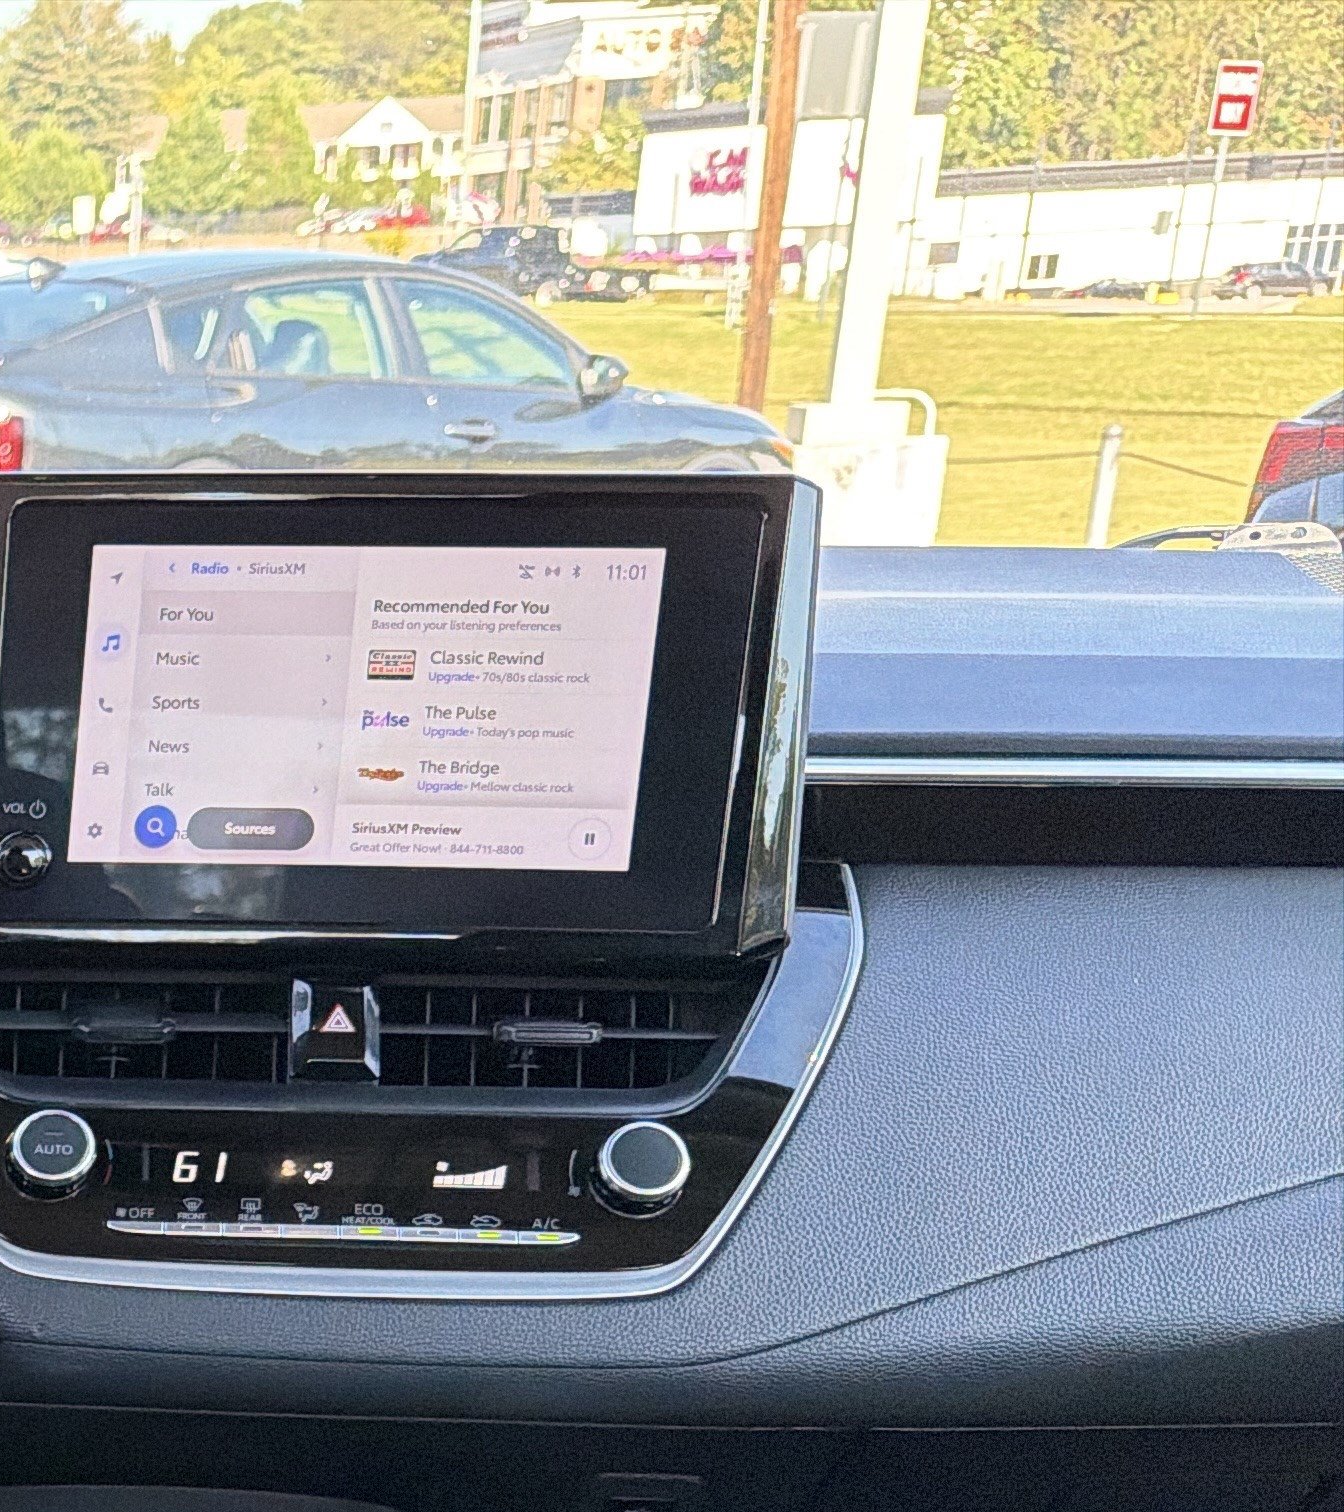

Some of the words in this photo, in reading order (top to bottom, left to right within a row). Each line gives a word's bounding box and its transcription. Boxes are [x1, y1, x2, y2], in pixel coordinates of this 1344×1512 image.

[190, 562, 229, 575] Radio
[248, 562, 307, 576] SiriusXM
[606, 564, 648, 581] 11:01
[159, 607, 183, 622] For
[186, 607, 214, 622] You
[373, 600, 490, 615] Recommended
[493, 600, 518, 615] For
[520, 601, 550, 615] You
[371, 619, 404, 631] Based
[406, 622, 421, 631] on
[422, 622, 448, 633] your
[449, 620, 496, 633] listening
[498, 621, 562, 633] preferences
[155, 651, 200, 666] Music
[430, 650, 484, 666] Classic
[487, 651, 544, 667] Rewind
[428, 672, 475, 684] Upgrade
[482, 672, 525, 684] 70s/80s
[527, 673, 564, 684] classic
[565, 673, 590, 684] rock
[151, 695, 200, 712] Sports
[424, 705, 452, 719] The
[455, 706, 497, 720] Pulse
[422, 726, 469, 739] Upgrade
[476, 727, 515, 739] Today's
[517, 729, 540, 739] pop
[541, 728, 574, 739] music
[148, 740, 190, 754] News
[419, 760, 447, 774] The
[450, 761, 500, 777] Bridge
[144, 782, 175, 797] Talk
[417, 780, 464, 793] Upgrade
[470, 781, 511, 793] Mellow
[512, 782, 548, 793] classic
[549, 783, 574, 793] rock
[2, 802, 27, 814] VOL
[224, 821, 277, 836] Sources
[351, 822, 408, 836] SiriusXM
[411, 823, 462, 836] Preview
[349, 842, 381, 853] Great
[382, 842, 411, 854] Offer
[412, 843, 442, 854] Now!
[33, 1143, 73, 1155] AUTO
[172, 1151, 228, 1183] 61
[128, 1207, 155, 1219] OFF
[177, 1212, 207, 1220] FRONT
[354, 1203, 384, 1216] ECO
[341, 1216, 396, 1226] HEAT/COOL
[531, 1218, 560, 1230] A/C
